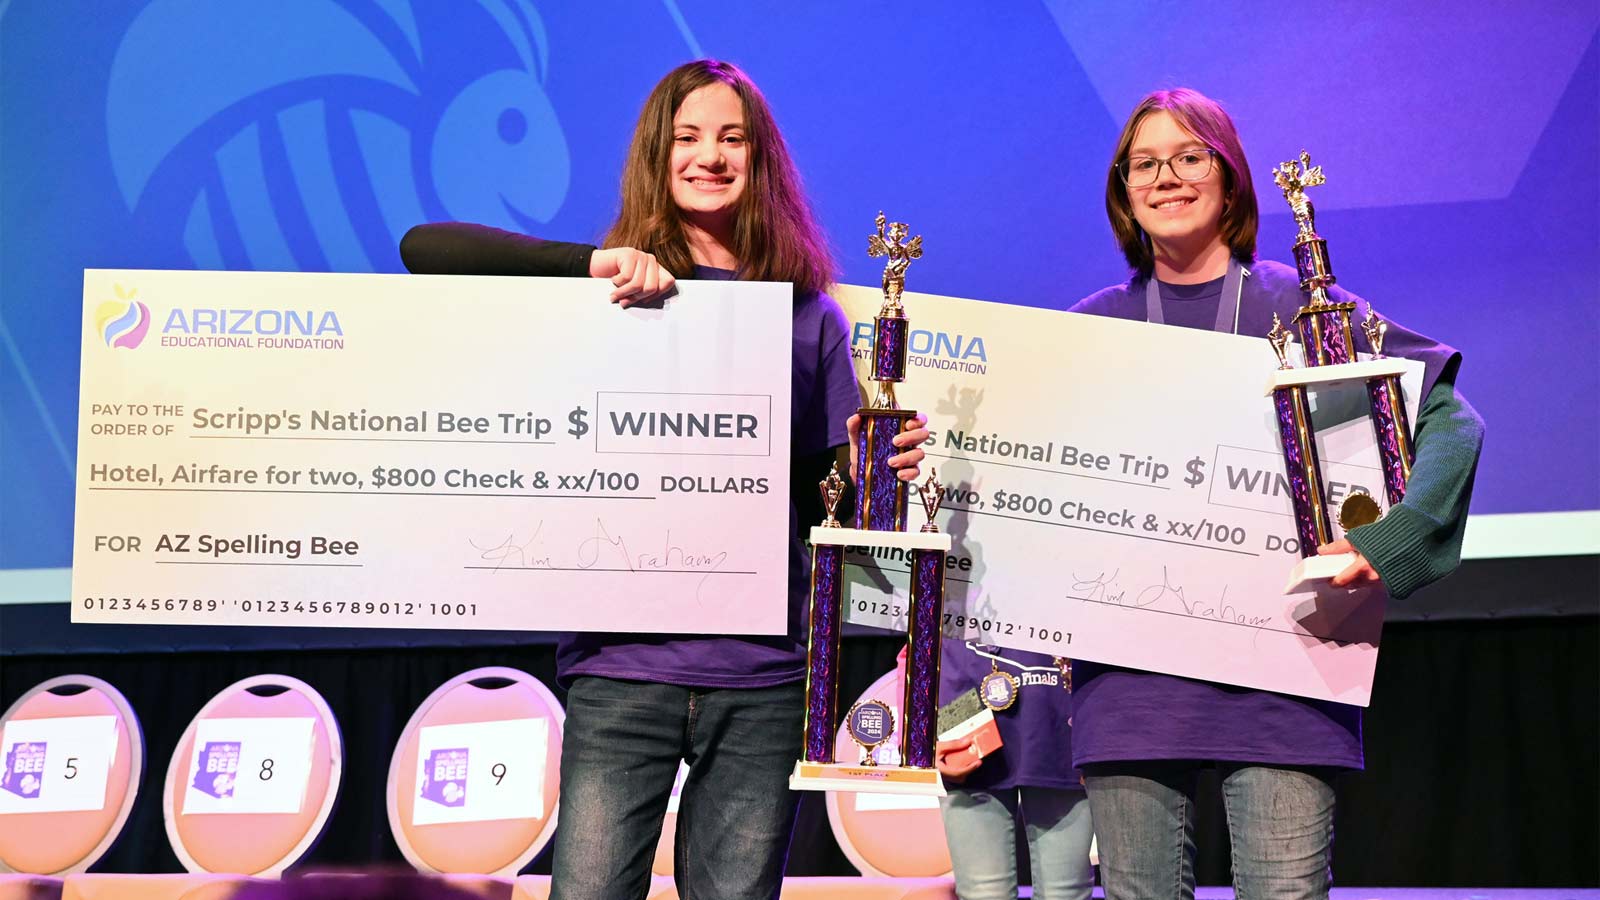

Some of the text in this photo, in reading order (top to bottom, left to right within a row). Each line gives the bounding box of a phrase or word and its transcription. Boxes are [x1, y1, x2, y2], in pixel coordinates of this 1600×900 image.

[162, 308, 344, 336] ARIZONA
[160, 336, 344, 350] EDUCATIONAL FOUNDATION
[852, 322, 987, 362] RONA
[908, 355, 987, 375] FOUNDATION
[91, 403, 184, 417] PAY TO THE
[91, 423, 175, 436] ORDER OF
[192, 406, 759, 439] Scripp's National Bee Trip $ WINNER
[944, 429, 1052, 463] National
[1059, 444, 1111, 471] Bee
[1119, 452, 1170, 483] Trip
[1183, 455, 1206, 488] $
[1225, 464, 1372, 506] WINE
[89, 463, 769, 494] Hotel, Airfare for two, $800 Check & xx/100 DOLLARS
[946, 487, 985, 509] wo,
[992, 489, 1053, 516] $800
[1059, 501, 1136, 529] Check
[1142, 513, 1160, 532] &
[1166, 518, 1247, 545] xx/100
[94, 534, 360, 559] FOR AZ Spelling Bee
[845, 545, 973, 571] elling ee
[430, 603, 478, 616] 1001
[1028, 626, 1073, 645] 1001
[1021, 672, 1058, 686] Finals
[861, 719, 882, 729] BEE
[13, 758, 45, 773] BEE
[64, 757, 79, 779] 5
[206, 758, 239, 773] BEE
[259, 758, 274, 781] 8
[434, 765, 467, 782] BEE
[491, 763, 507, 785] 9
